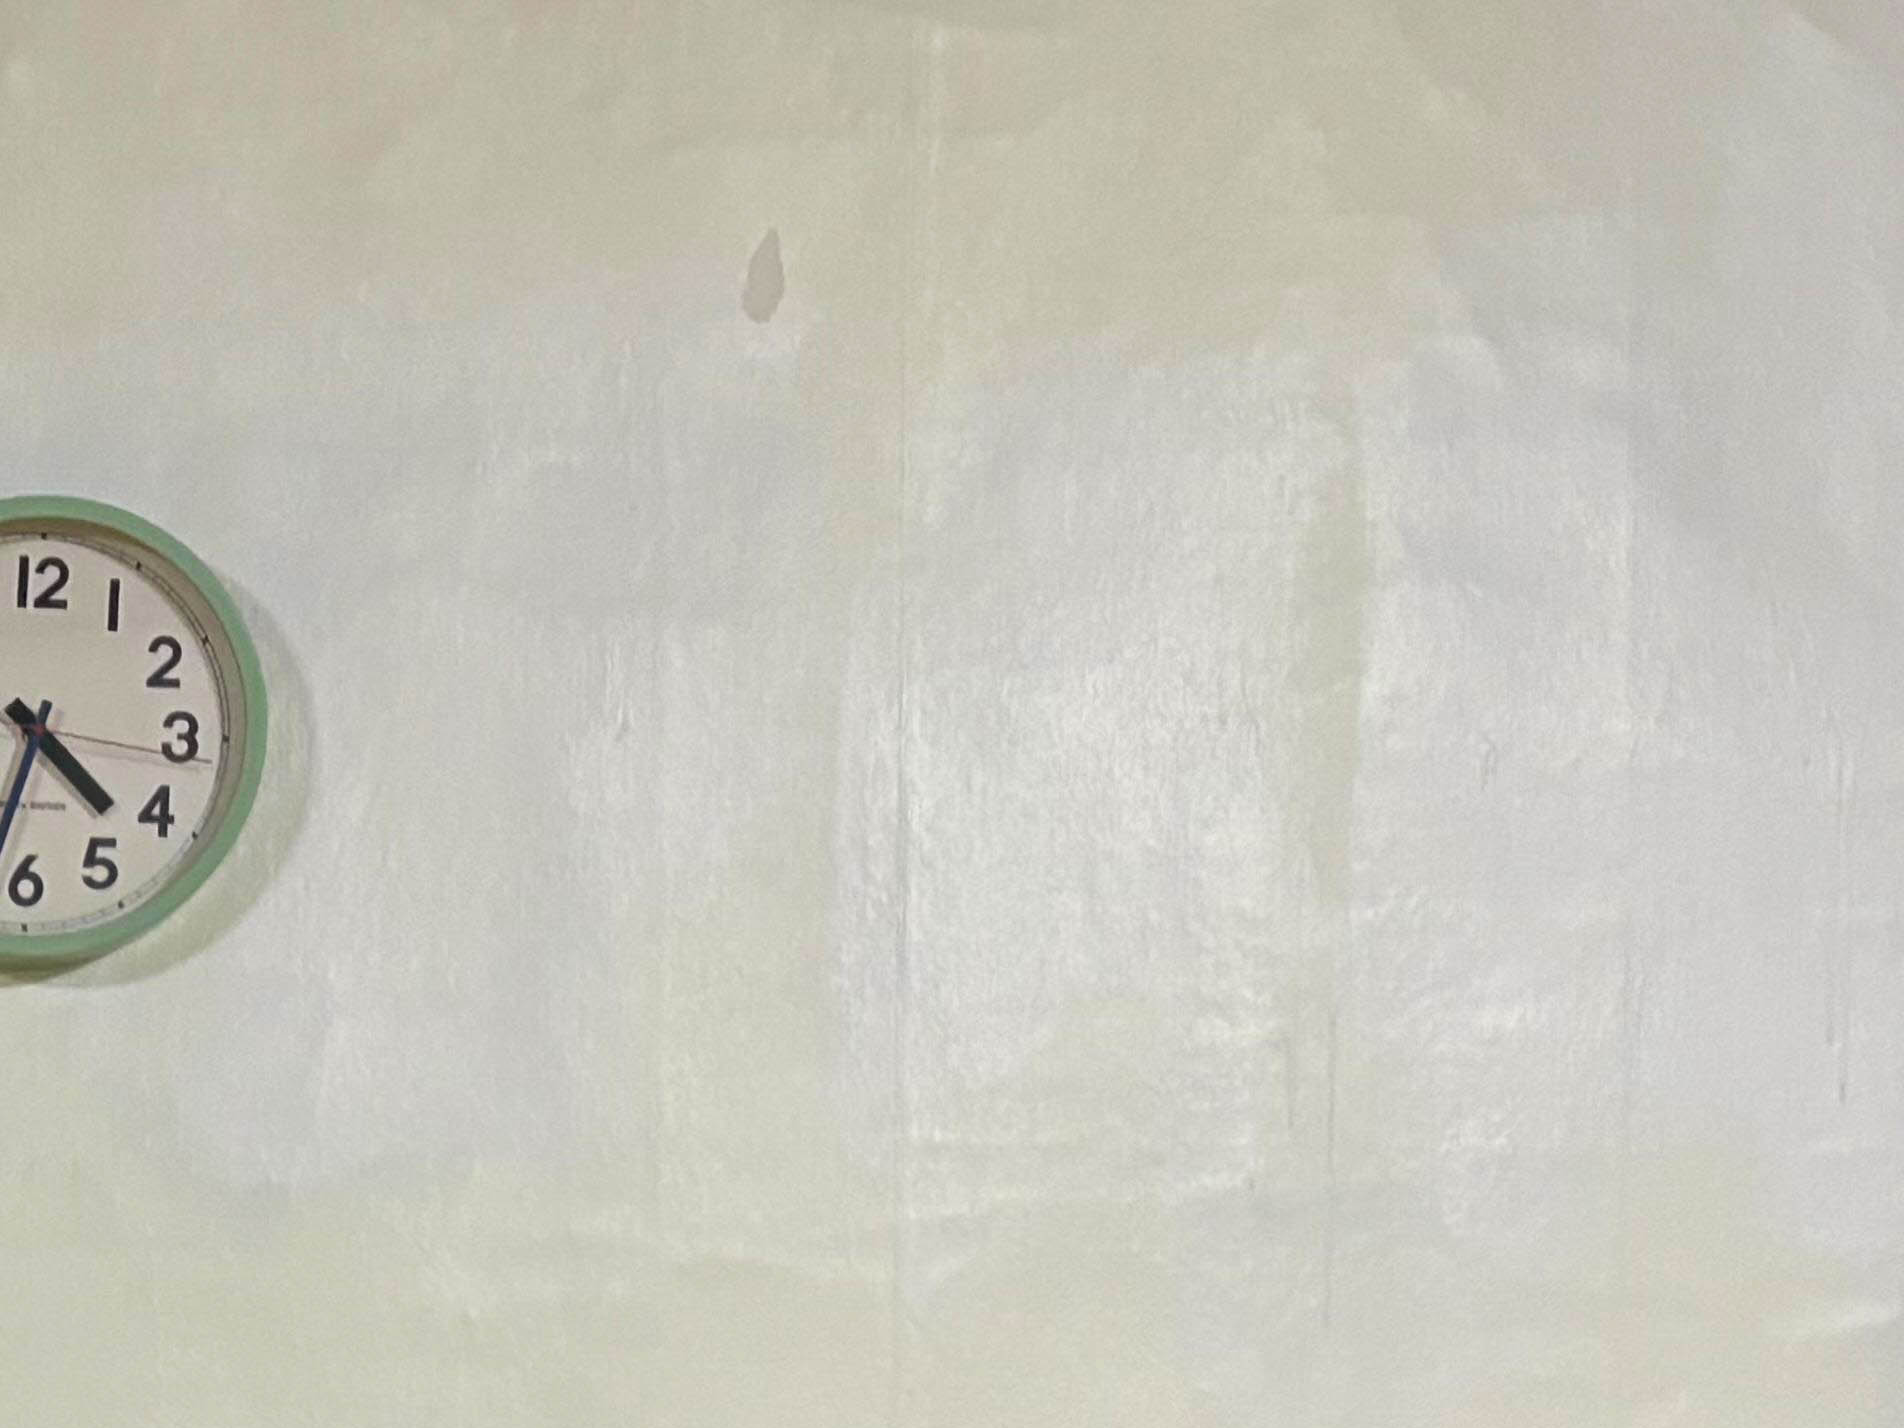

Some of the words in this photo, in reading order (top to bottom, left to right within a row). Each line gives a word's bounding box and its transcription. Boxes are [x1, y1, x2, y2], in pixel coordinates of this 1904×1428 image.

[18, 555, 69, 609] 12
[107, 579, 120, 632] 1
[147, 636, 182, 688] 2
[161, 711, 199, 763] 3
[138, 785, 175, 837] 4
[9, 854, 43, 907] 6
[82, 837, 118, 890] 5
